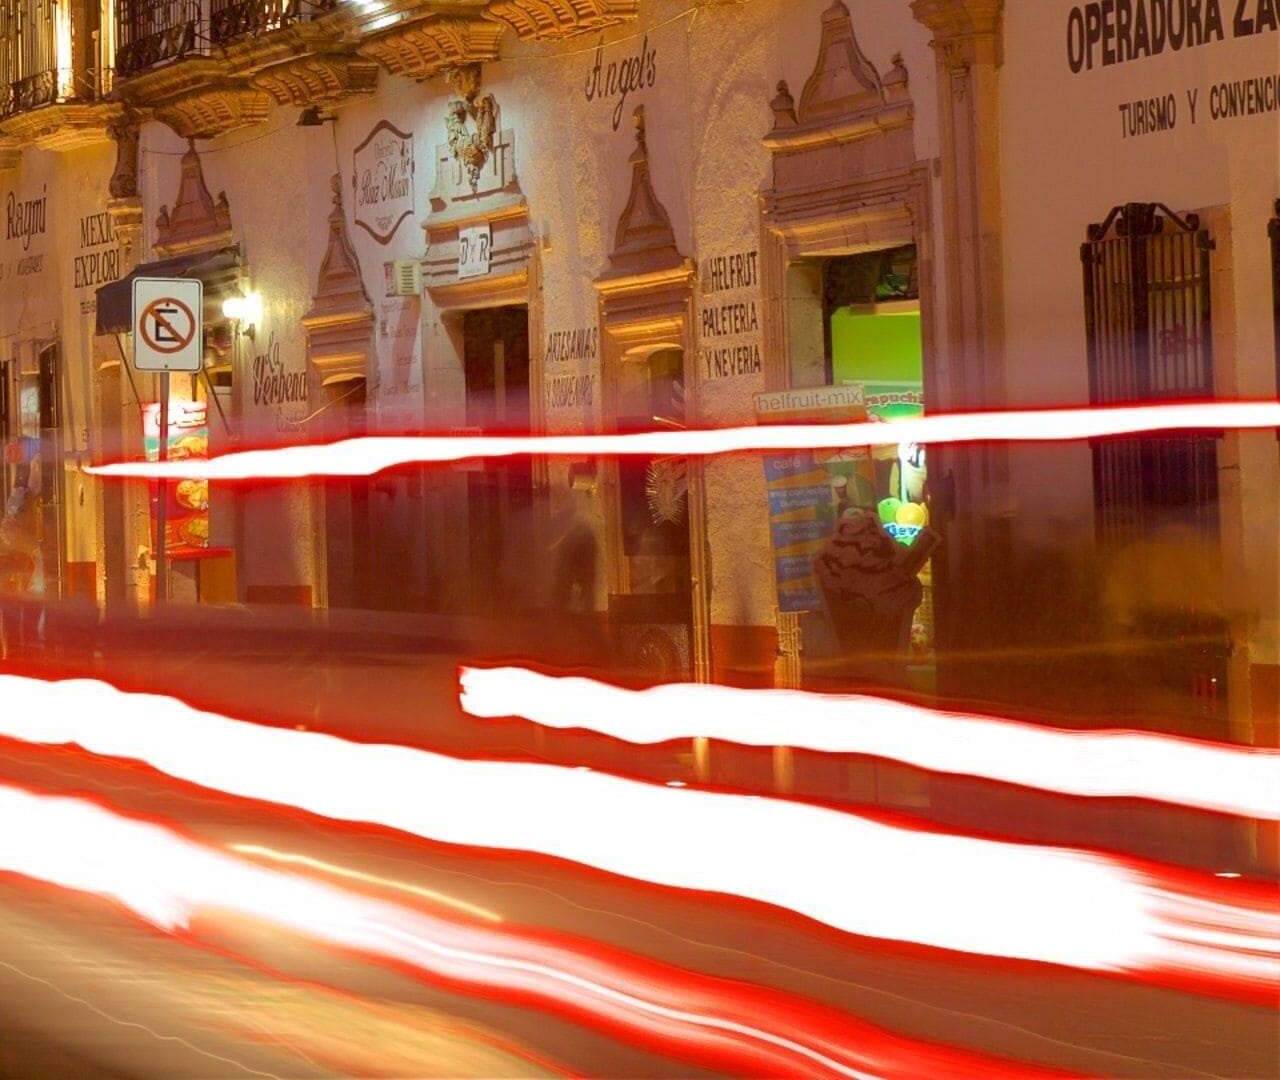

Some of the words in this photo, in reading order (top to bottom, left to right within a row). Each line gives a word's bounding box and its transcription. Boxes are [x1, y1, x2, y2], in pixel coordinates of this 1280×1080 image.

[585, 34, 657, 132] Angel's
[1119, 92, 1177, 139] TURISMO
[1187, 88, 1198, 125] Y
[6, 183, 47, 251] Raymi
[710, 251, 758, 293] HELFRUT
[702, 301, 759, 338] PALETERIA
[253, 353, 307, 407] Verbena
[705, 350, 713, 379] Y
[715, 345, 762, 378] NEVERIA
[757, 389, 861, 412] helfruit-mix
